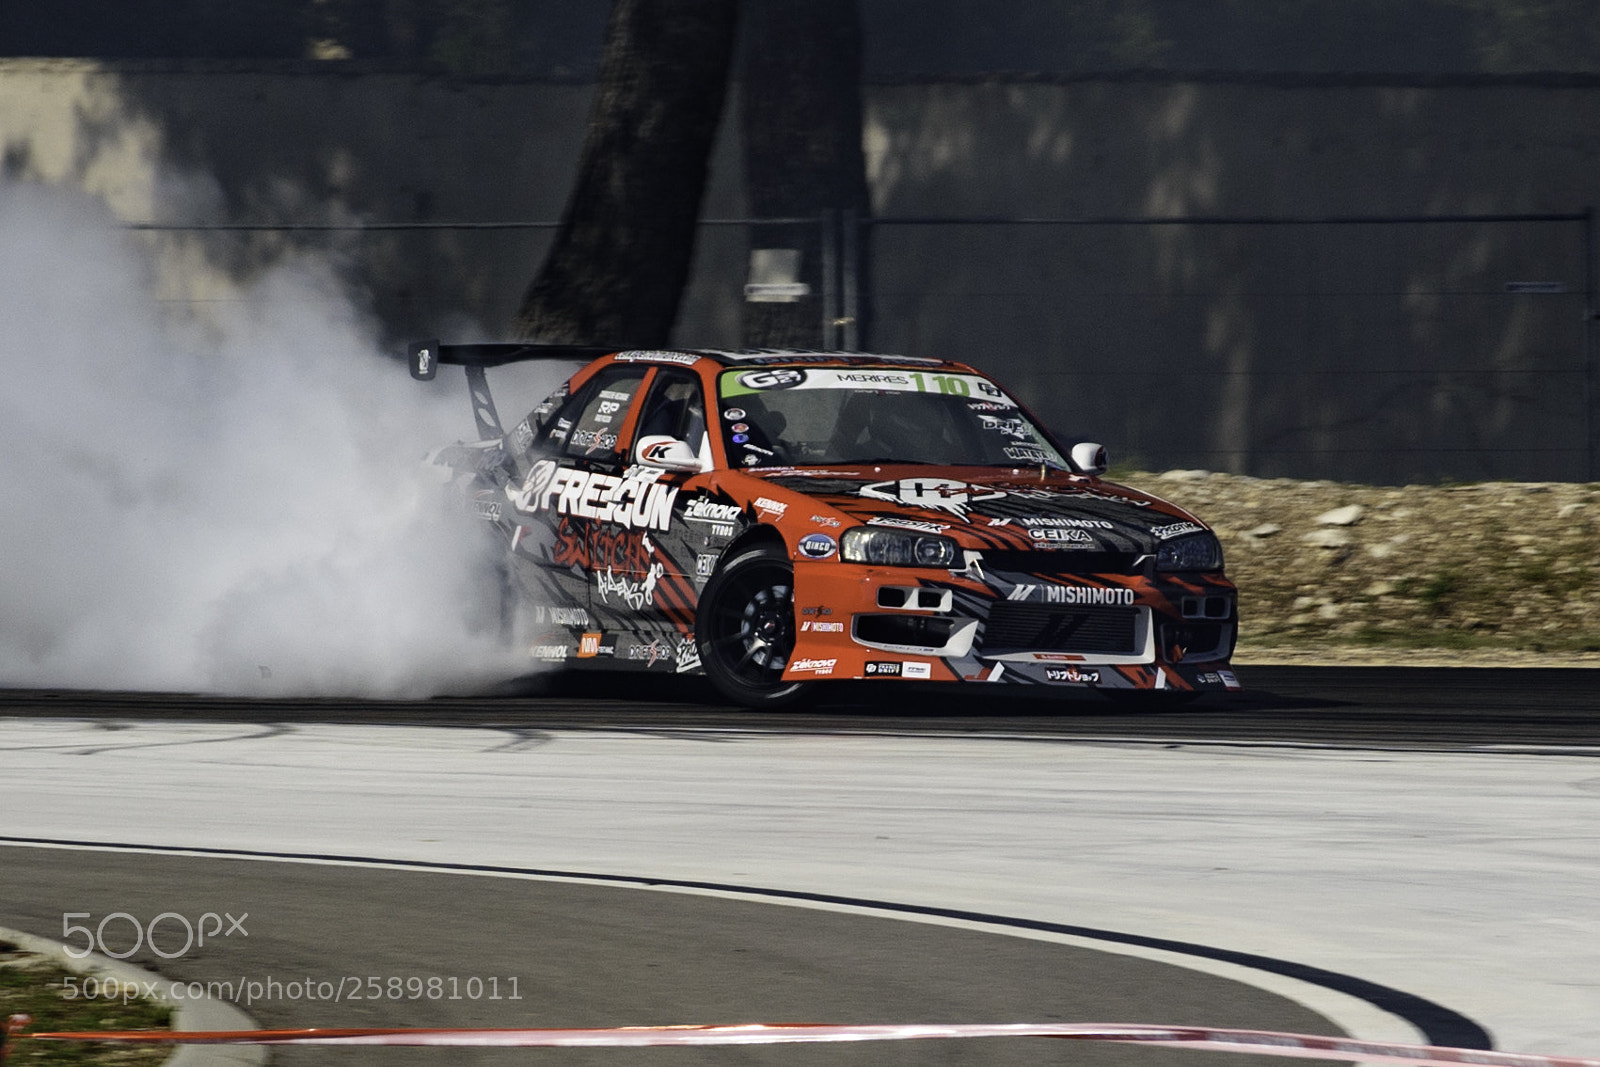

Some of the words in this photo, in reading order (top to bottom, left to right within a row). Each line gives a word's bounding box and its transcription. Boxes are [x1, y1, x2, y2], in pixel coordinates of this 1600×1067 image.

[1020, 518, 1114, 529] MISHIMOTO
[1028, 528, 1092, 541] CEIKA
[1047, 585, 1134, 605] MISHIMOTO
